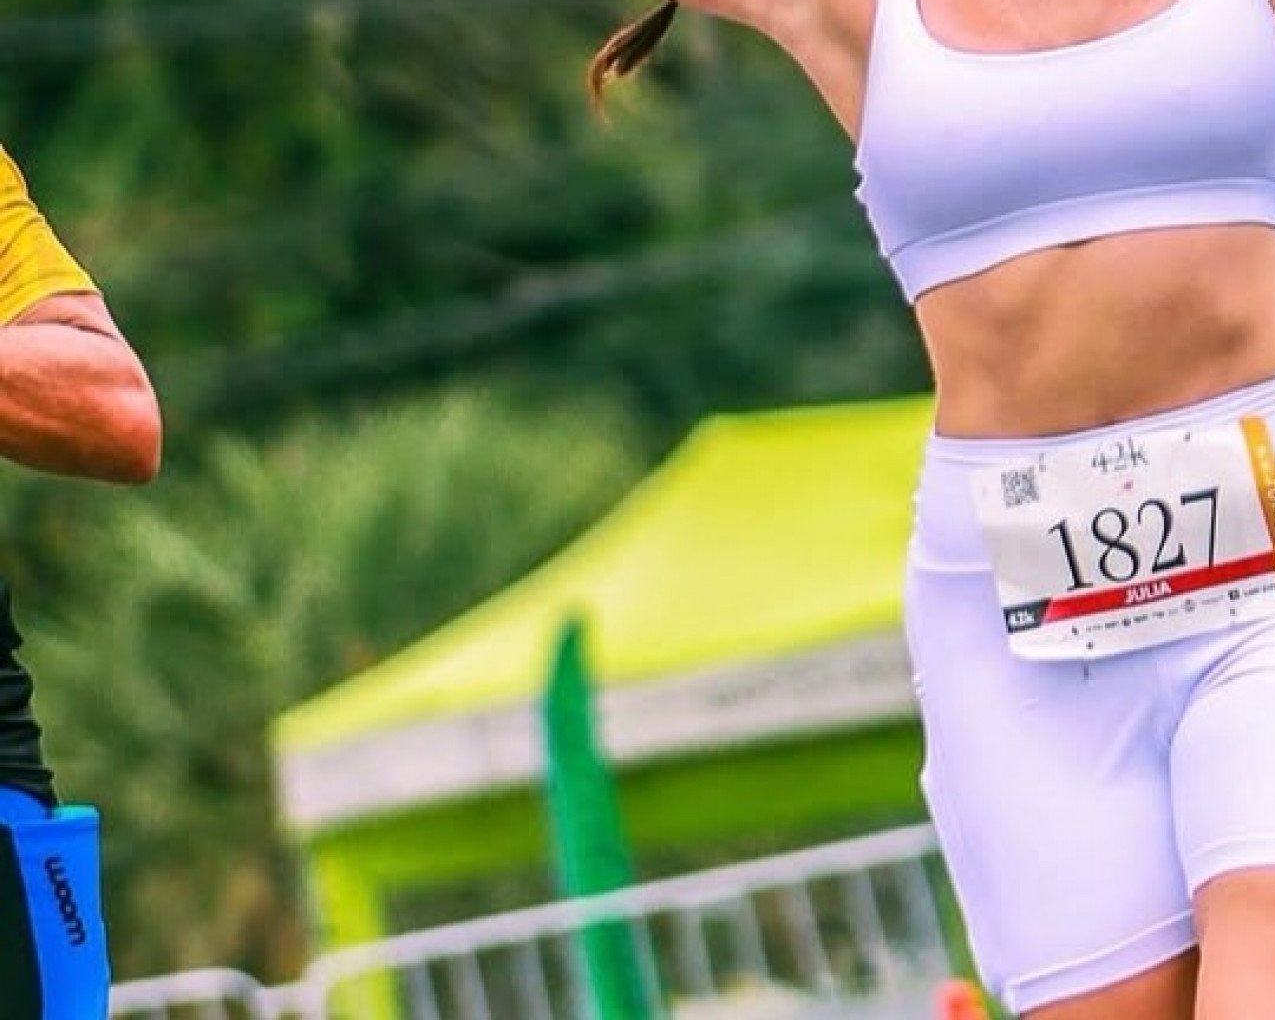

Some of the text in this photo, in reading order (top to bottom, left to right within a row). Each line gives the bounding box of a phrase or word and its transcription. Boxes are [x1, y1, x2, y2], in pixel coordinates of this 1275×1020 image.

[1048, 487, 1219, 591] 1827
[1125, 580, 1172, 604] JULIA
[45, 855, 86, 947] woom
